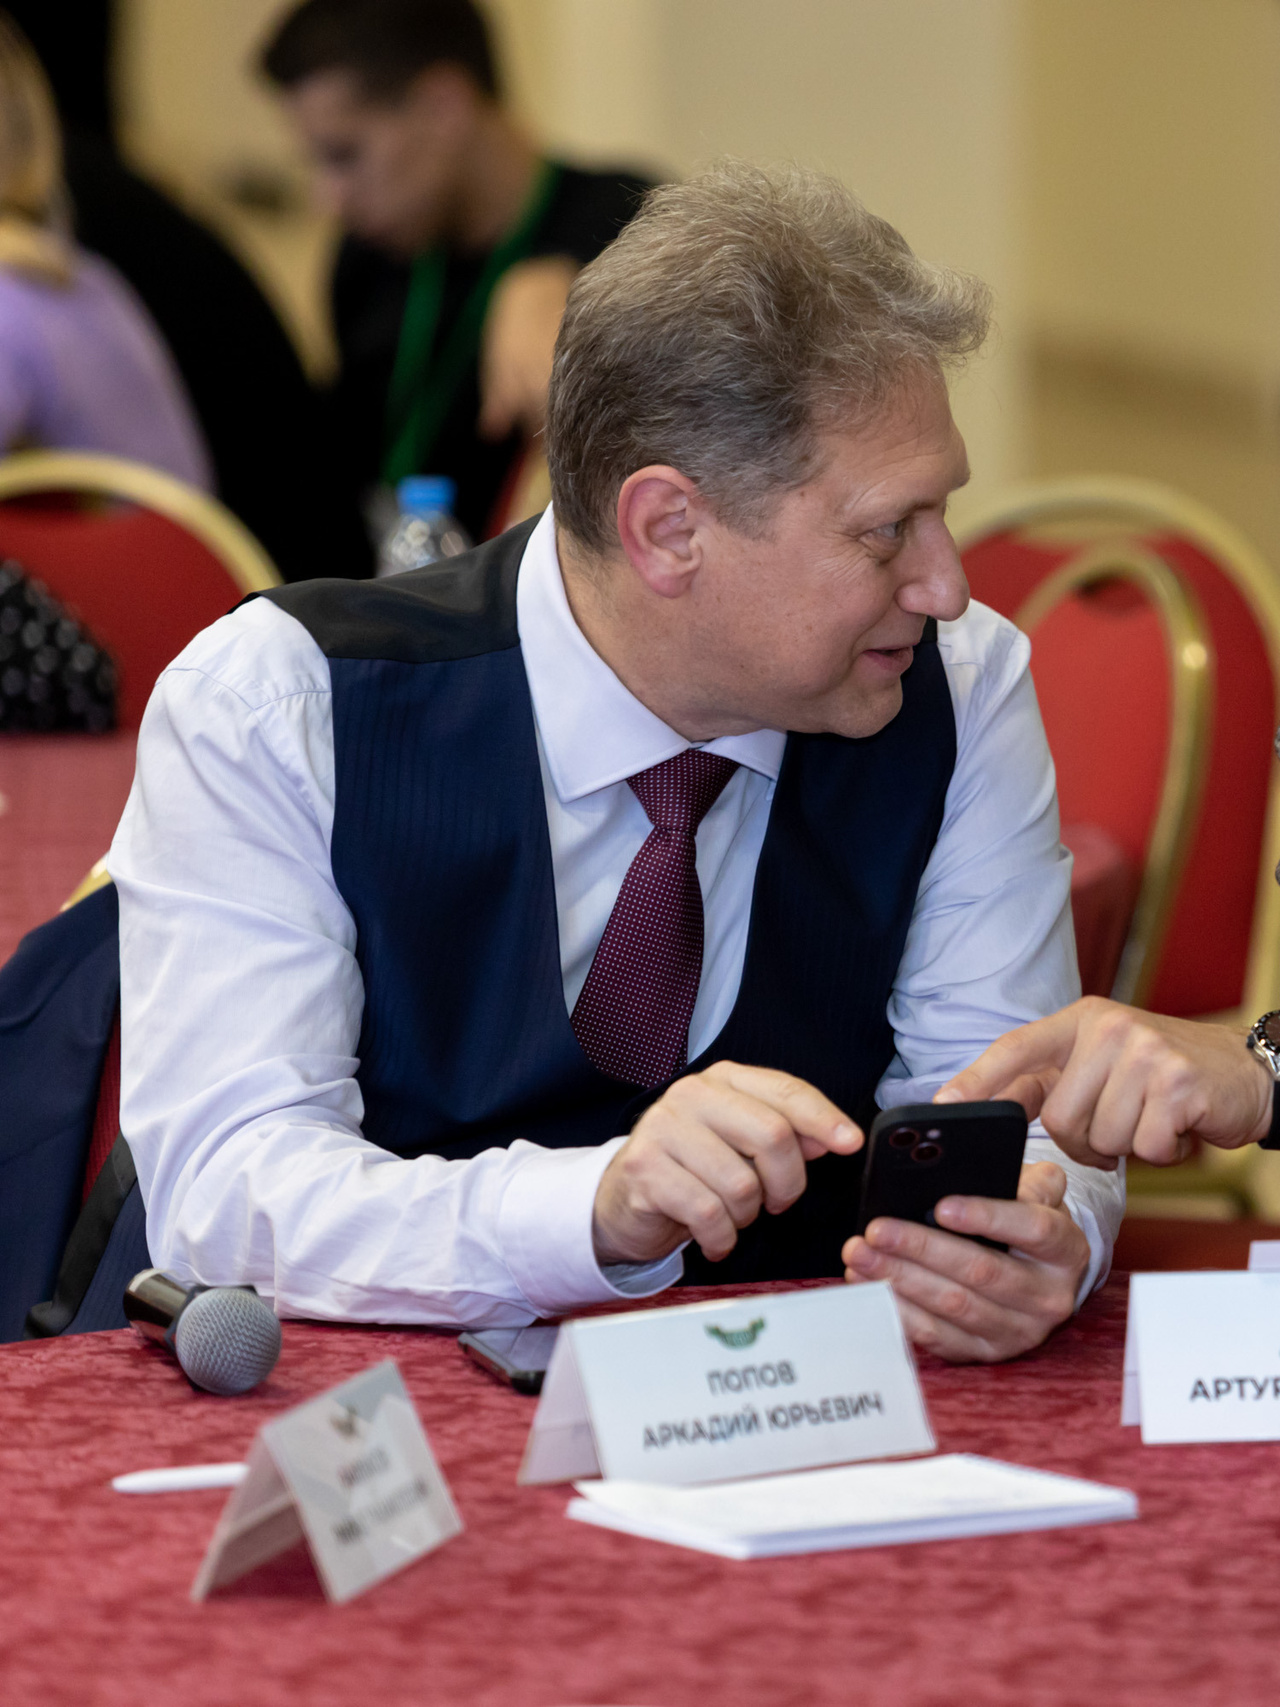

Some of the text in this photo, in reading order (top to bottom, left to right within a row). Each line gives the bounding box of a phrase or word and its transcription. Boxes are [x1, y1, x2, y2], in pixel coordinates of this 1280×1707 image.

[707, 1361, 796, 1394] ПОПОВ
[643, 1392, 884, 1450] АРКАДИЙ ЮРЬЕВИЧ
